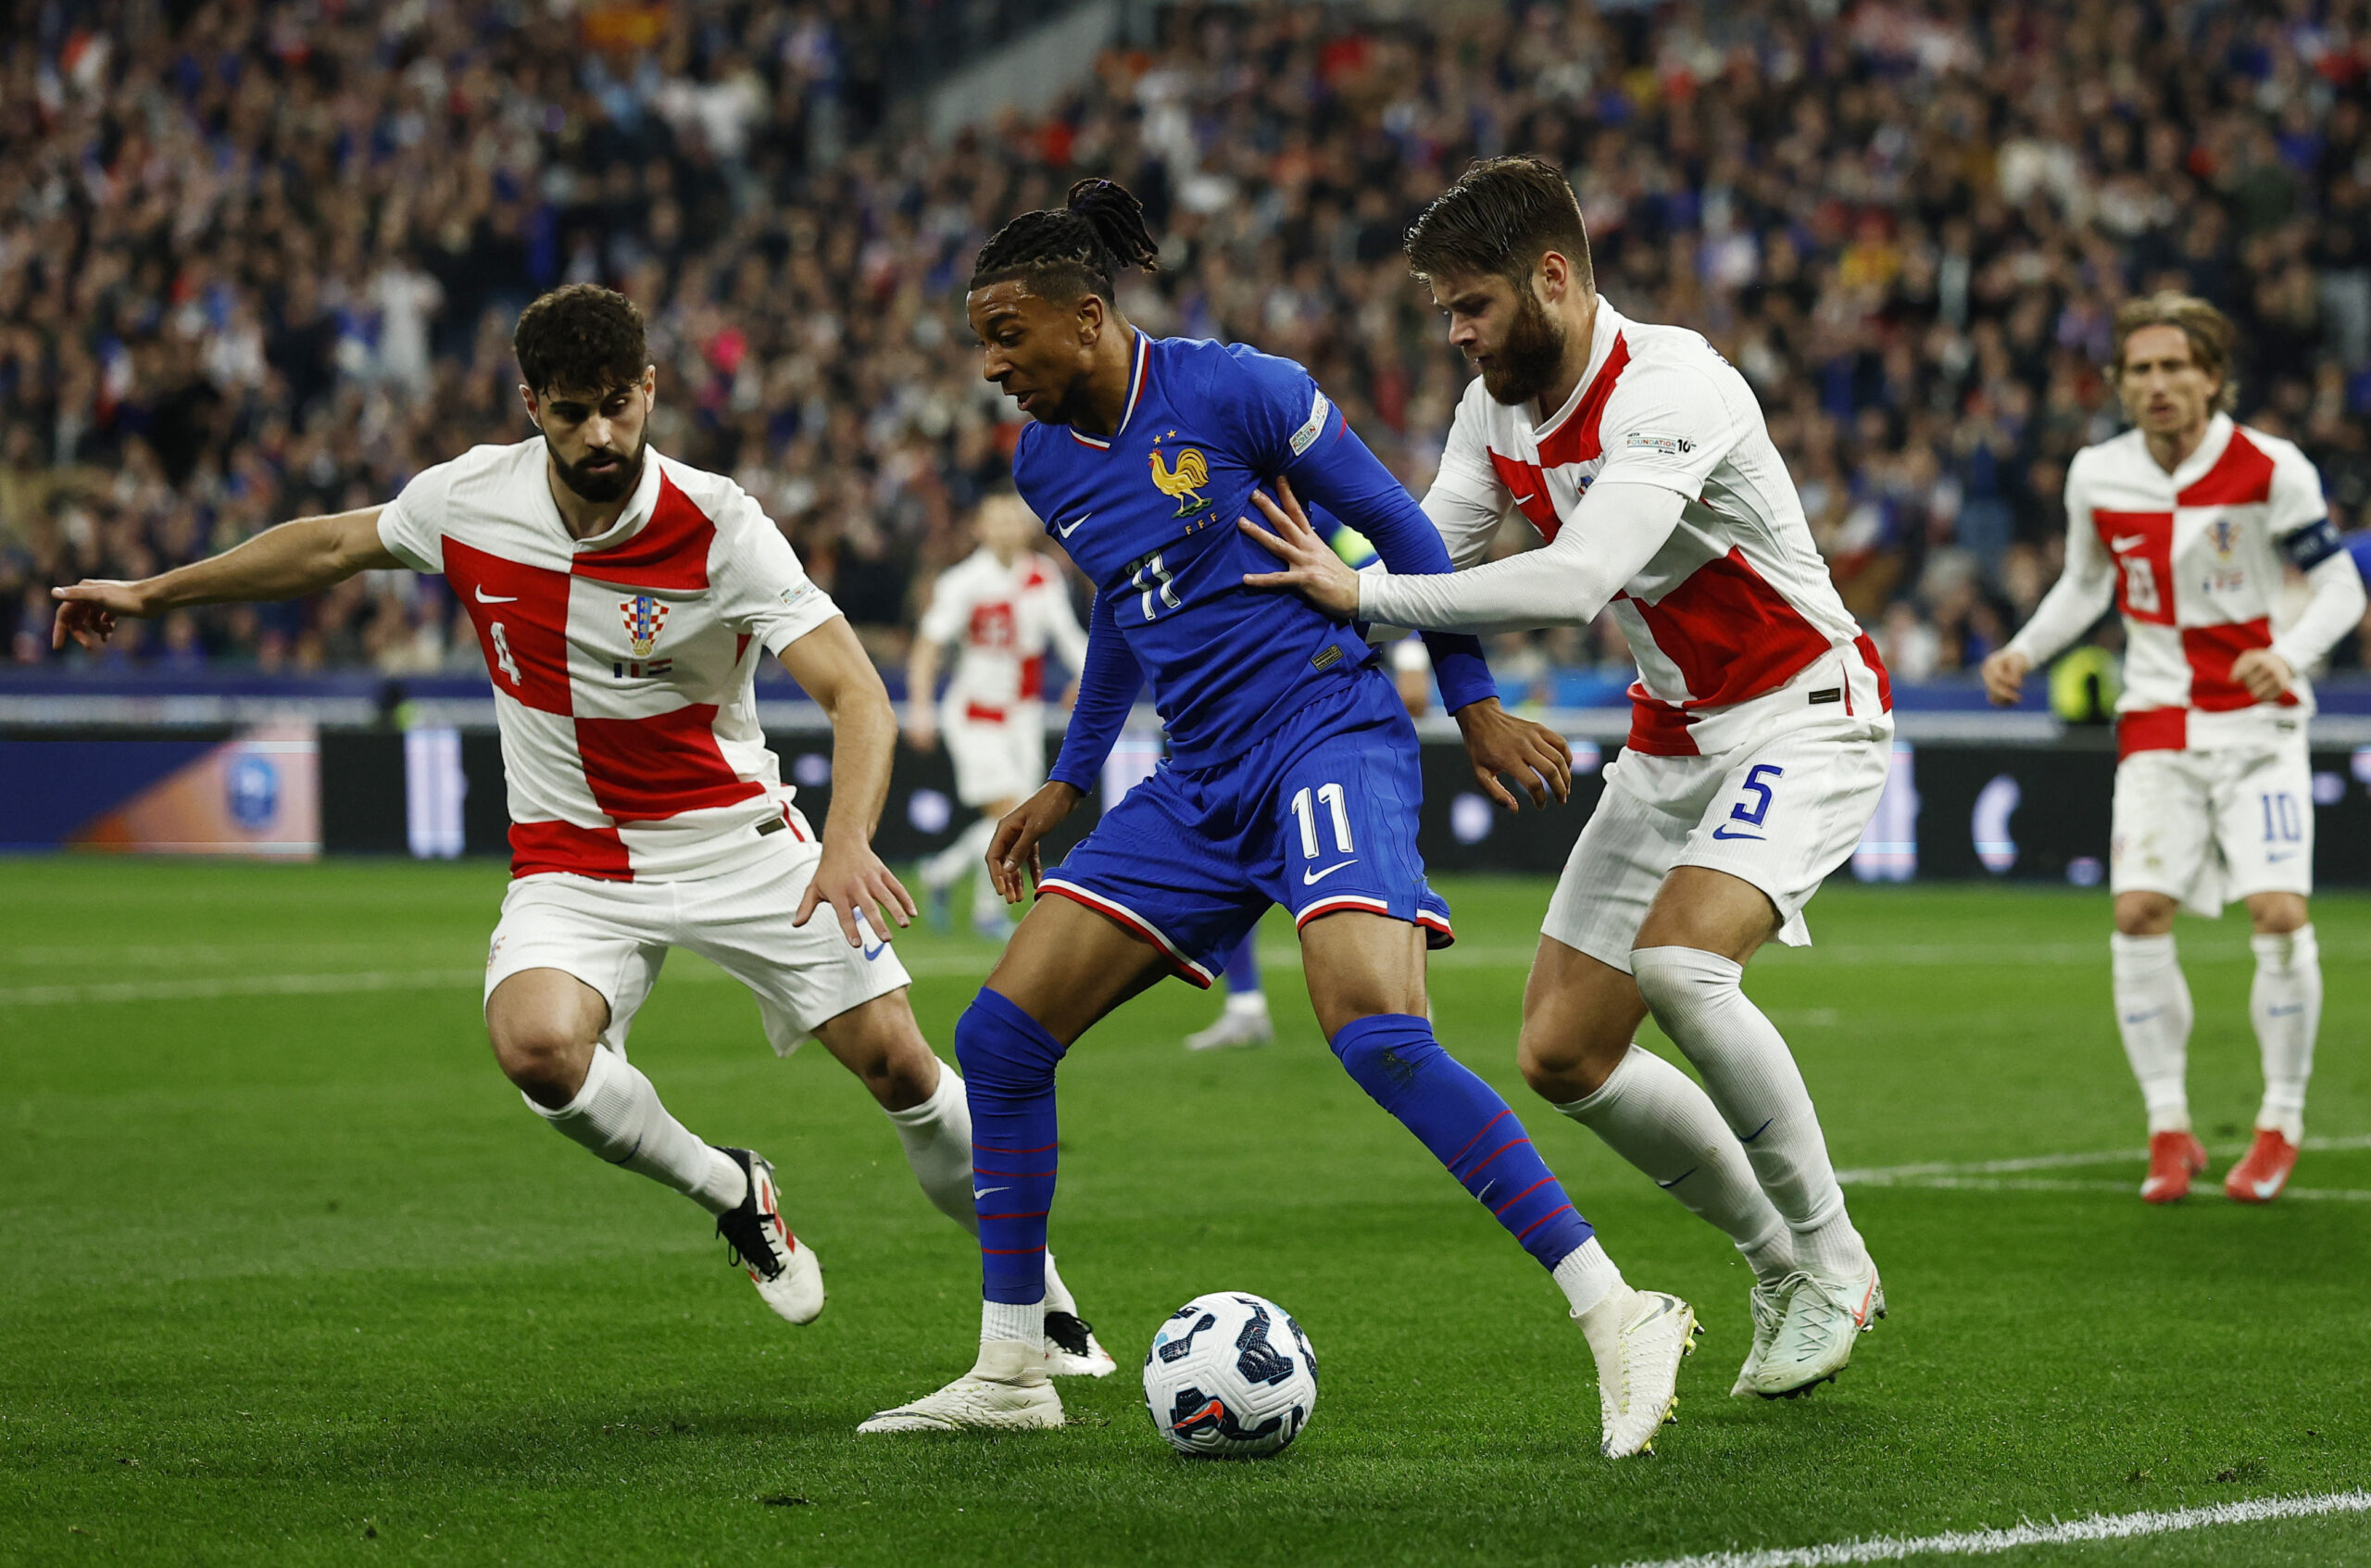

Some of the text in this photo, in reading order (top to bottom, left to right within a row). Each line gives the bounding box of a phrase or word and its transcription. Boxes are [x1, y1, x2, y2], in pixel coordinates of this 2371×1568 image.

[1627, 438, 1676, 448] FOUNDATION
[1677, 438, 1691, 454] 10
[639, 599, 649, 633] HNS
[1124, 548, 1182, 621] 11
[490, 621, 522, 687] 4
[1290, 783, 1354, 859] 11
[1729, 763, 1786, 829] 5
[2261, 793, 2302, 843] 10
